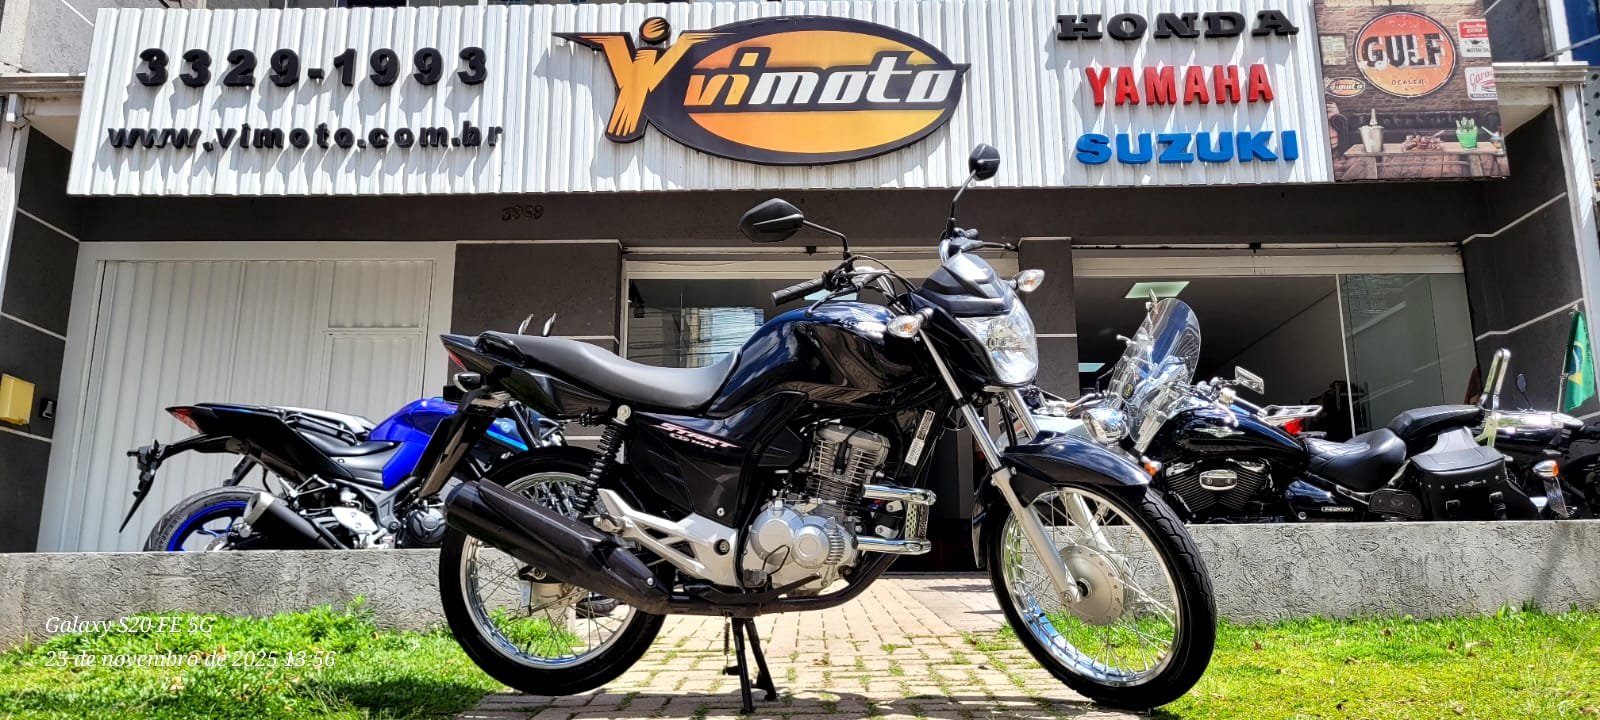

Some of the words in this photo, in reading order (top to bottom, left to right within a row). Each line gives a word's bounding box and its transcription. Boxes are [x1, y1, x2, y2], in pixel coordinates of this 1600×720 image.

[1057, 10, 1299, 40] HONDA
[136, 47, 488, 87] 3329-1993
[1362, 33, 1445, 68] GULF
[683, 52, 955, 107] vimoto
[1085, 63, 1274, 106] YAMAHA
[108, 120, 502, 153] www.vimoto.com.br
[1075, 130, 1299, 165] SUZUKI
[654, 422, 740, 448] START
